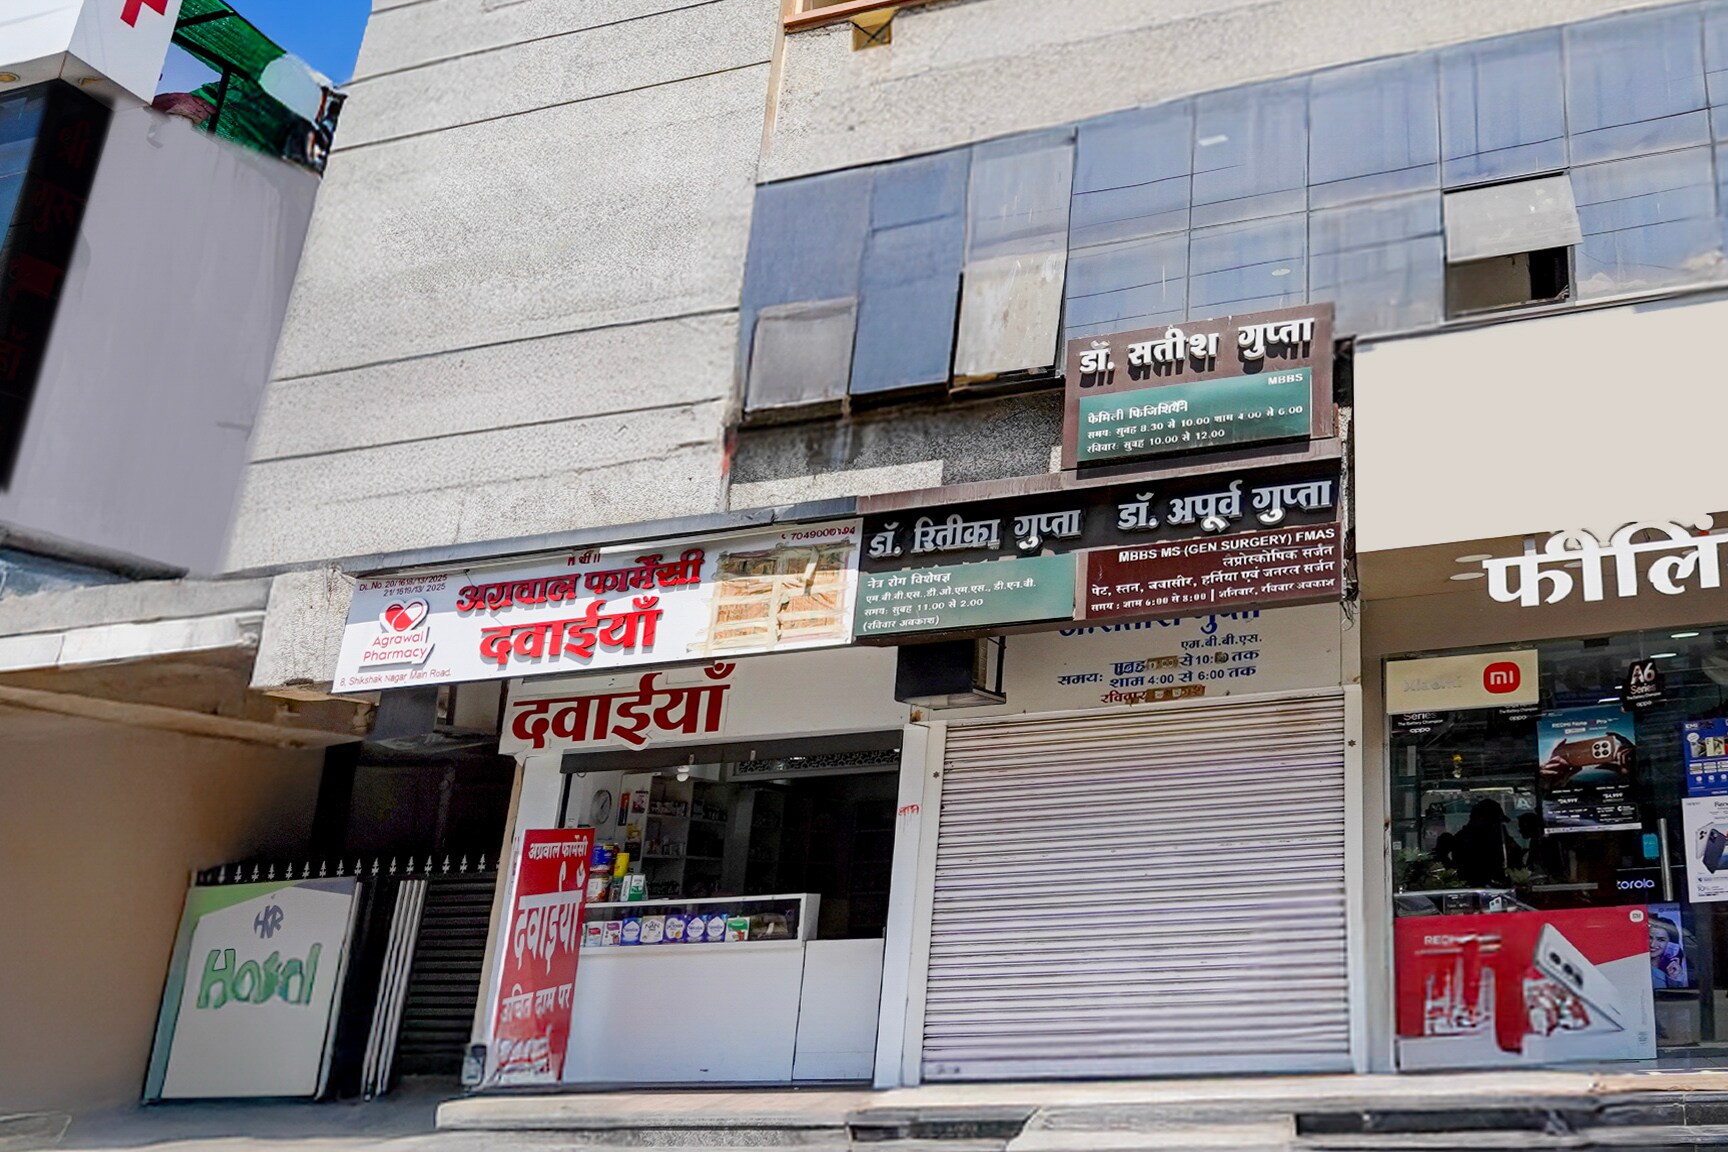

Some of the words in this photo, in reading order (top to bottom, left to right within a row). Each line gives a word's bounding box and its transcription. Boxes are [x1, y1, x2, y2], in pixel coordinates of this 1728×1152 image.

[1080, 340, 1115, 374] डॉ.
[1127, 325, 1219, 366] सतीश
[1238, 317, 1316, 361] गुप्ता
[1267, 373, 1304, 386] MBBS
[1140, 422, 1163, 434] 8.30
[1181, 415, 1210, 428] 10.00
[1150, 434, 1178, 447] 10.00
[1195, 428, 1225, 440] 12.00
[1117, 491, 1159, 531] डॉ.
[1166, 479, 1243, 533] अपूर्व
[1251, 480, 1332, 526] गुप्ता
[868, 521, 902, 557] डॉ.
[1013, 509, 1082, 550] गुप्ता
[1118, 549, 1157, 563] MBBS
[1161, 545, 1181, 558] MS
[1184, 541, 1218, 557] (GEN
[1220, 532, 1293, 551] SURGERY)
[1295, 528, 1335, 543] FMAS
[1302, 544, 1334, 558] सर्जन
[888, 574, 906, 588] रोग
[1091, 583, 1112, 598] पेट,
[1303, 560, 1334, 573] सर्जन
[456, 573, 581, 612] अग्रवाल
[917, 601, 945, 612] 11.00
[960, 598, 984, 608] 2.00
[373, 631, 424, 647] Agrawal
[480, 596, 664, 666] दवाईयाँ
[363, 646, 428, 663] Pharmacy
[1195, 652, 1229, 665] 10:
[1231, 649, 1260, 662] तक
[349, 673, 383, 686] Shikshak
[410, 668, 428, 681] Main
[1057, 672, 1103, 686] समय:
[1148, 673, 1175, 685] 4:00
[1197, 668, 1225, 680] 6:00
[1227, 664, 1257, 678] तक
[1630, 662, 1656, 685] A6
[511, 662, 736, 749] दवाईयाँ
[1409, 726, 1431, 734] oppo
[1617, 877, 1656, 890] torola
[558, 983, 573, 1009] पर
